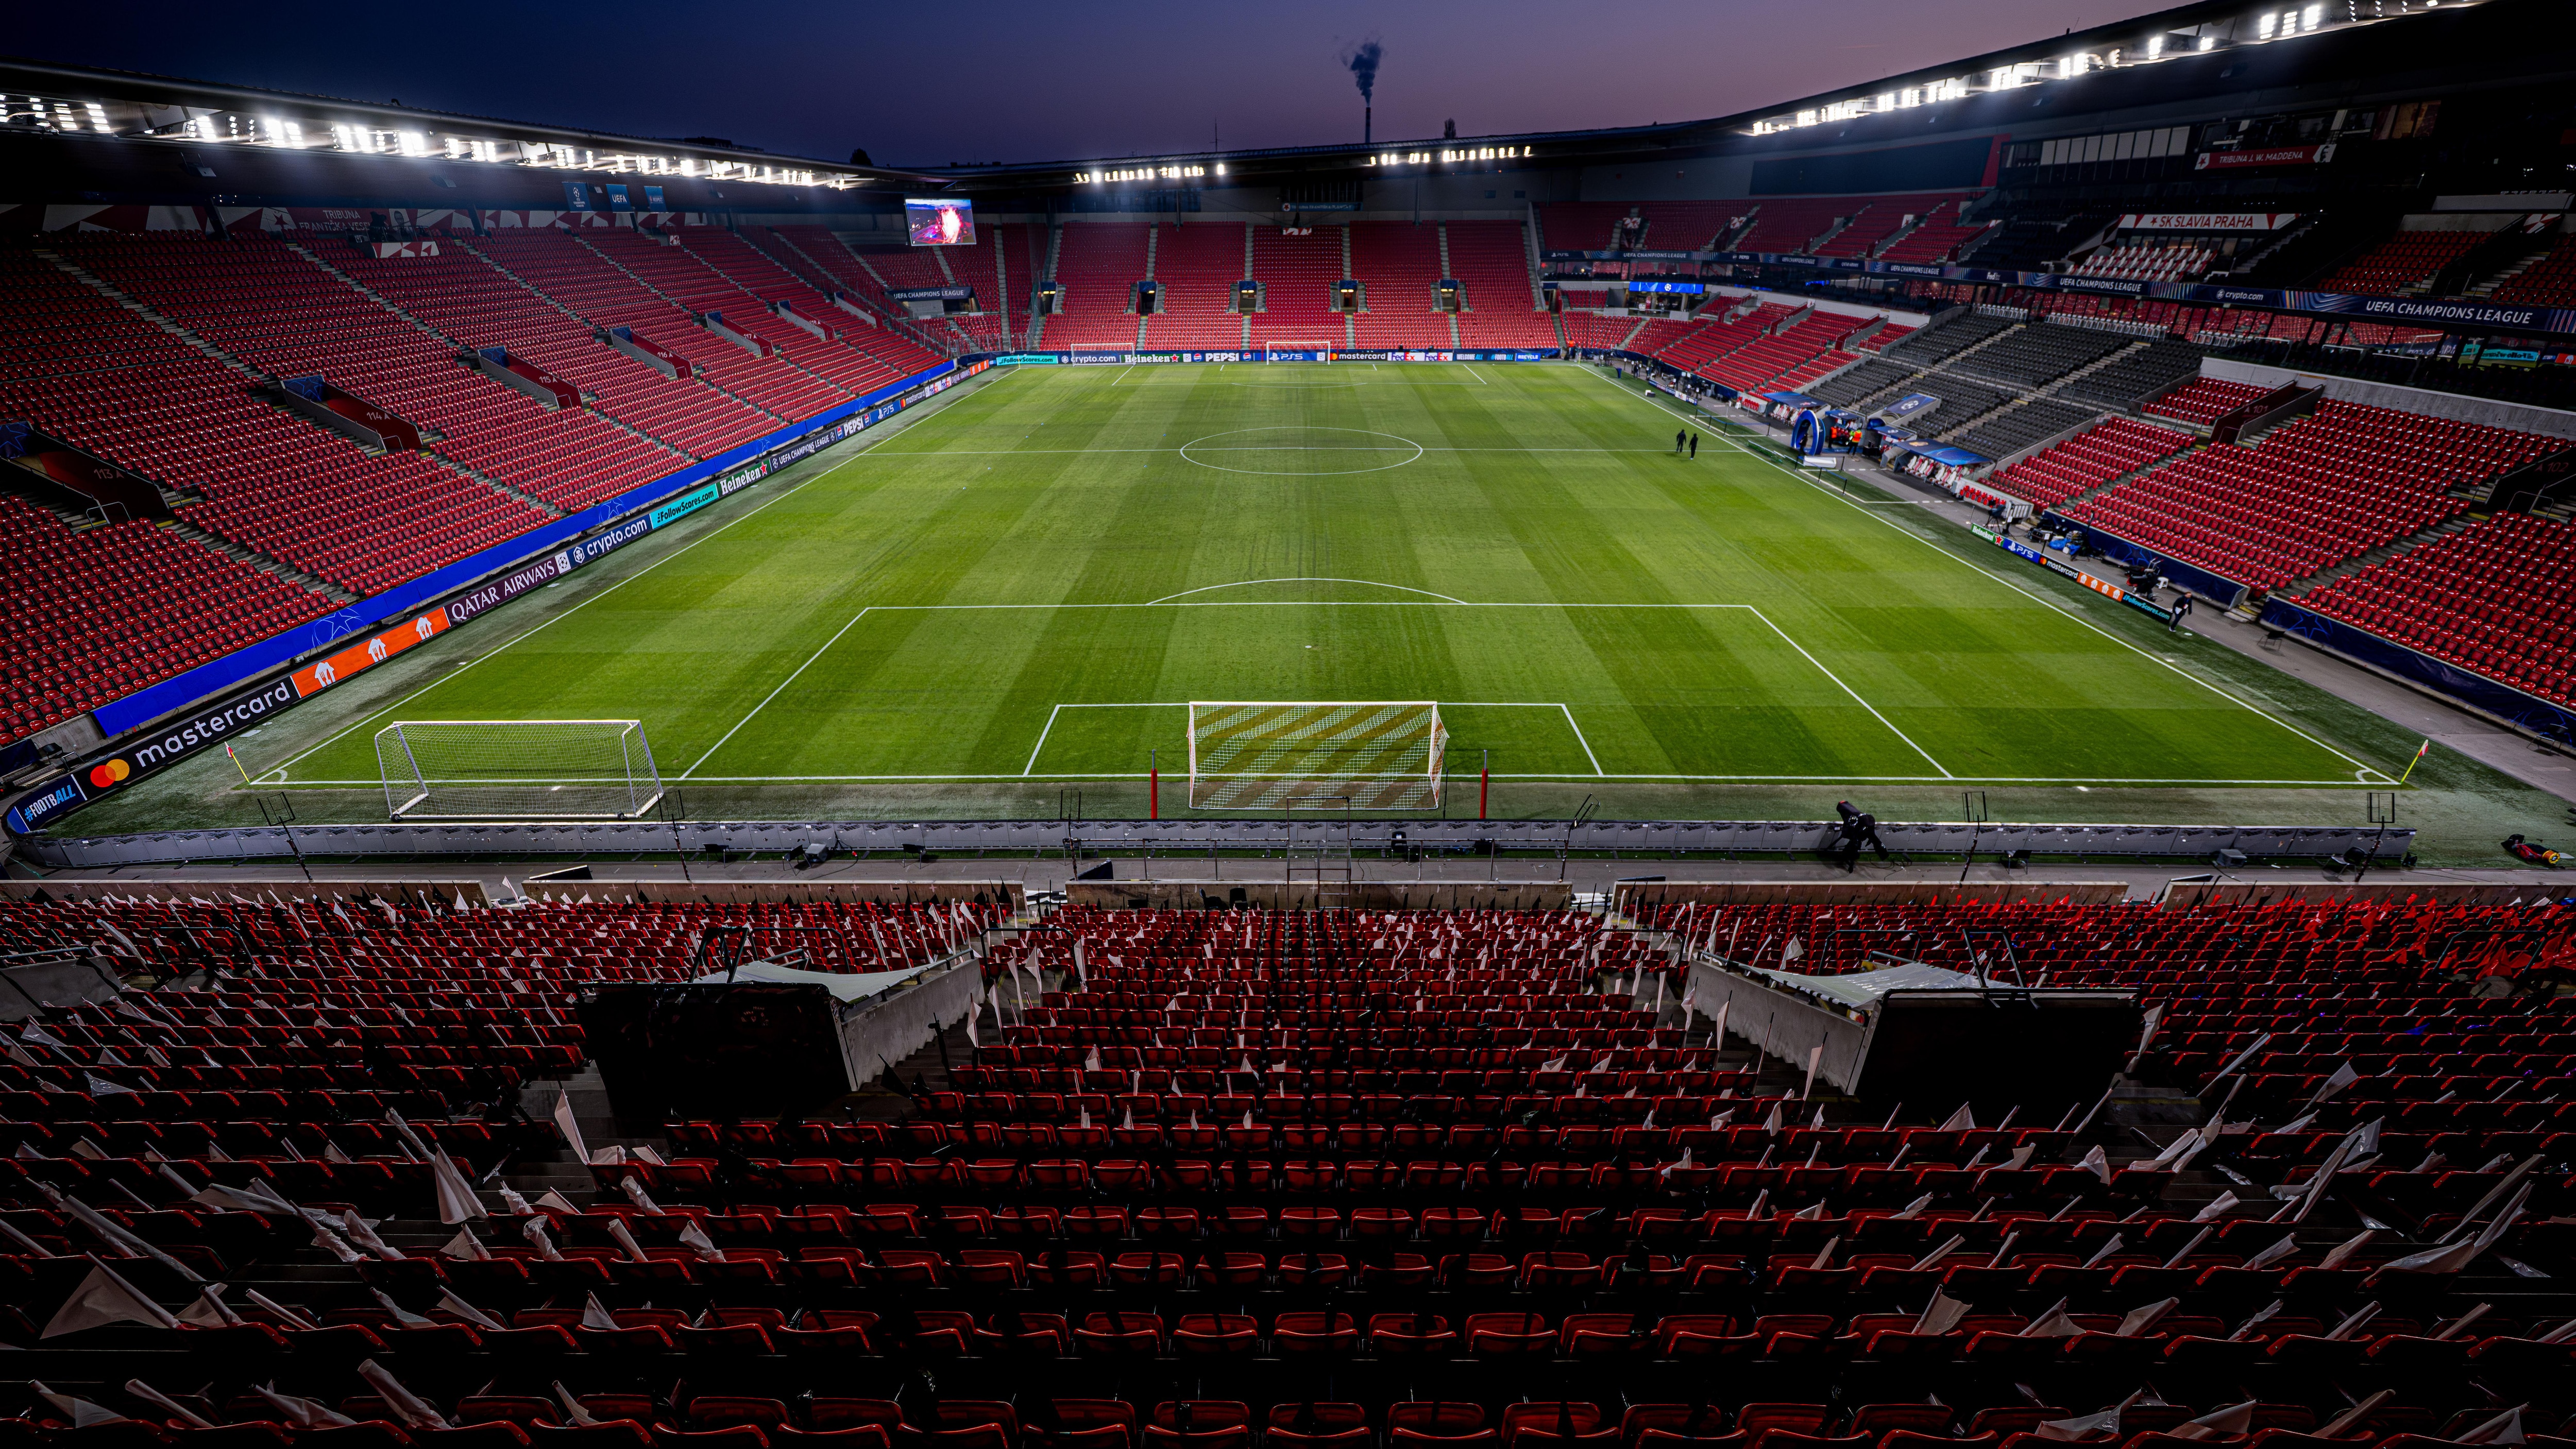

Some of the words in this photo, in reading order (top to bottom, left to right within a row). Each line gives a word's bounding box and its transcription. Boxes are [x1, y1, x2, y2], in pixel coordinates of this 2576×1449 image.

[2219, 155, 2248, 164] TRIBUNA
[2266, 151, 2303, 161] MADDENA
[612, 194, 627, 203] UEFA
[323, 210, 361, 219] TRIBUNA
[2159, 216, 2173, 227] SK
[2174, 216, 2210, 227] SLAVIA
[2214, 216, 2253, 228] PRAHA
[1901, 266, 1923, 274] CHAMPIONS
[2060, 278, 2075, 286] UEFA
[2076, 279, 2114, 289] CHAMPIONS
[2114, 282, 2142, 292] LEAGUE
[908, 291, 940, 299] CHAMPIONS
[2225, 291, 2264, 301] crypto.com
[2366, 300, 2395, 313] UEFA
[2398, 302, 2475, 319] CHAMPIONS
[2476, 309, 2533, 325] LEAGUE
[1071, 355, 1116, 364] crypto.com
[1125, 354, 1170, 363] Heineken
[1206, 353, 1239, 362] PEPSI
[1392, 352, 1415, 361] FedEx
[1425, 352, 1448, 361] FedEx
[905, 388, 925, 405] mastercard
[884, 404, 894, 416] PS5
[2253, 405, 2268, 414] 101
[367, 412, 382, 420] 114
[843, 416, 864, 436] PEPSI
[778, 454, 791, 465] UEFA
[791, 442, 815, 459] CHAMPIONS
[815, 435, 830, 448] LEAGUE
[2547, 462, 2569, 473] 102
[94, 468, 114, 480] 113
[720, 468, 761, 495] Heineken
[657, 489, 714, 523] FollowScores.com
[587, 519, 647, 556] crypto.com
[1972, 525, 1994, 541] Heineken
[2016, 546, 2034, 558] PS5
[2046, 560, 2078, 578] mastercard
[451, 586, 500, 620] QATAR
[504, 560, 555, 596] AIRWAYS
[2122, 594, 2170, 620] FollowScores.com
[135, 682, 291, 767] mastercard
[24, 785, 76, 822] #FOOTBALL
